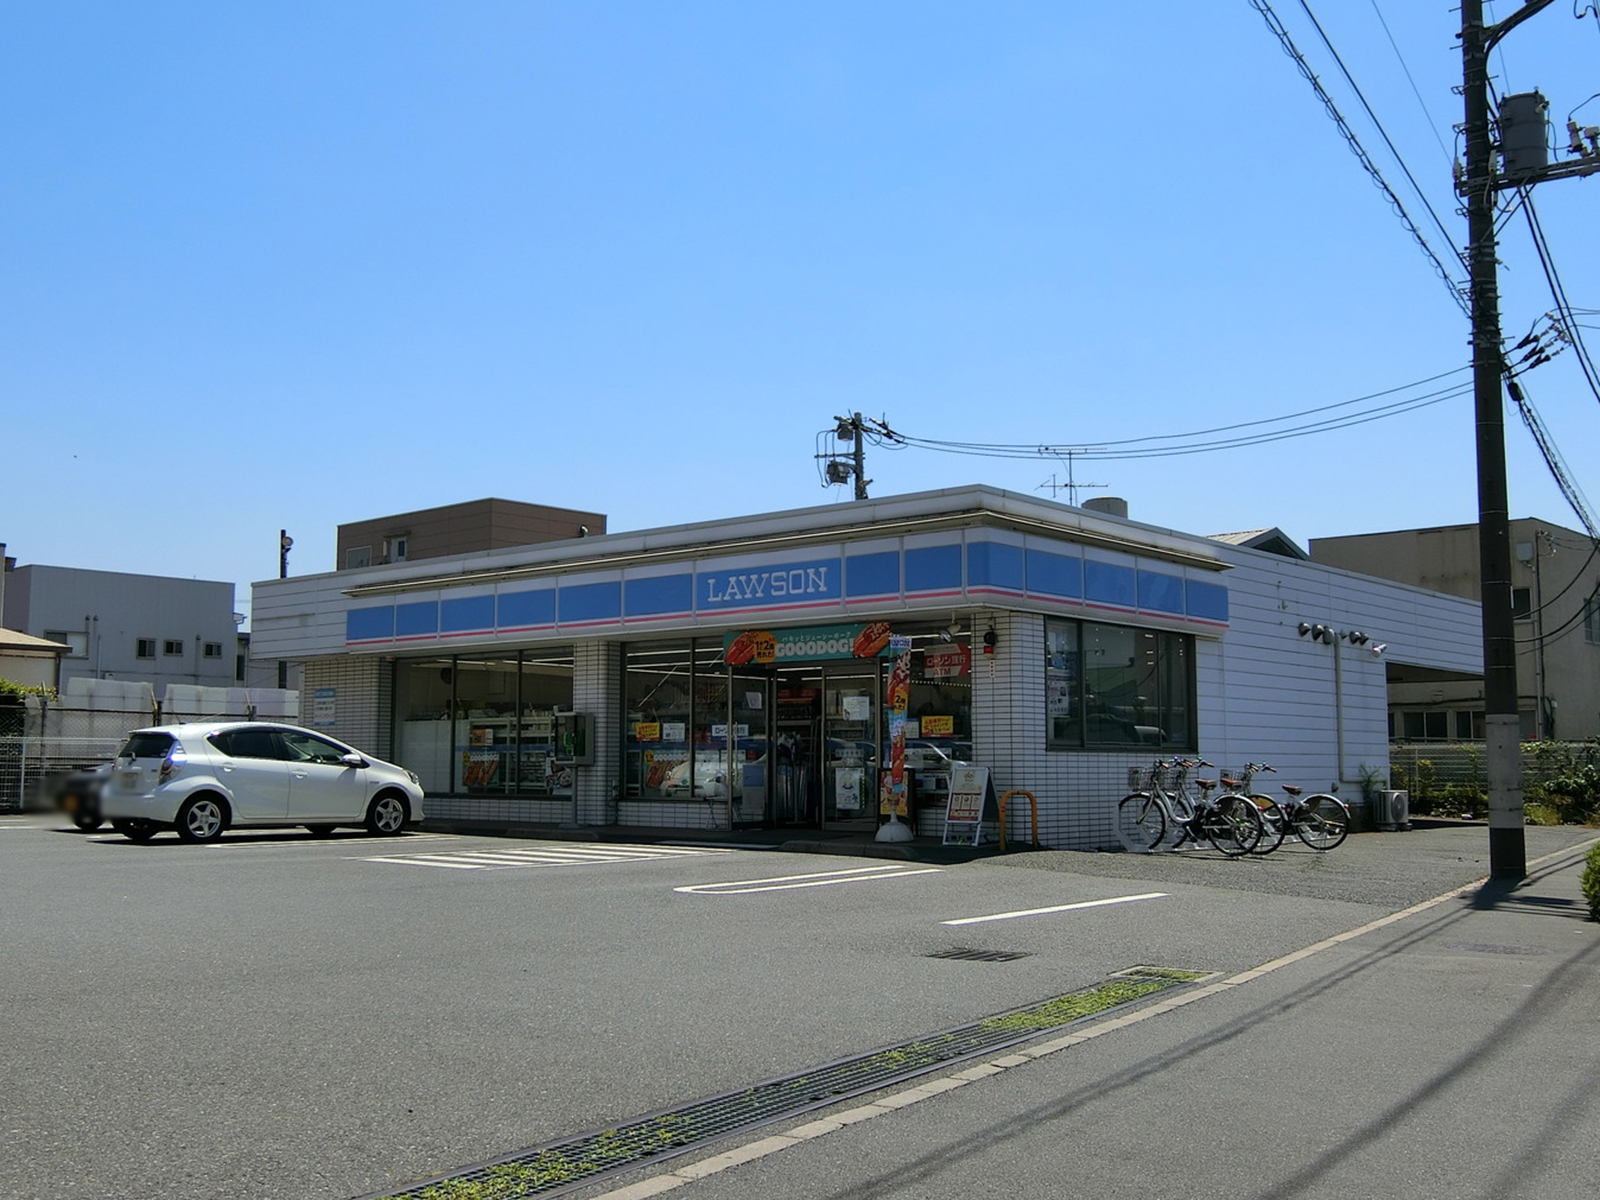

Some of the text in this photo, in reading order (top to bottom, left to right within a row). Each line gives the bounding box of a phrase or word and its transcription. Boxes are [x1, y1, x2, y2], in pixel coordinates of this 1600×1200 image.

[707, 567, 828, 601] LAWSON
[776, 638, 855, 658] GOOODOG!
[927, 654, 966, 666] ローソン銀行
[933, 667, 952, 677] ATM
